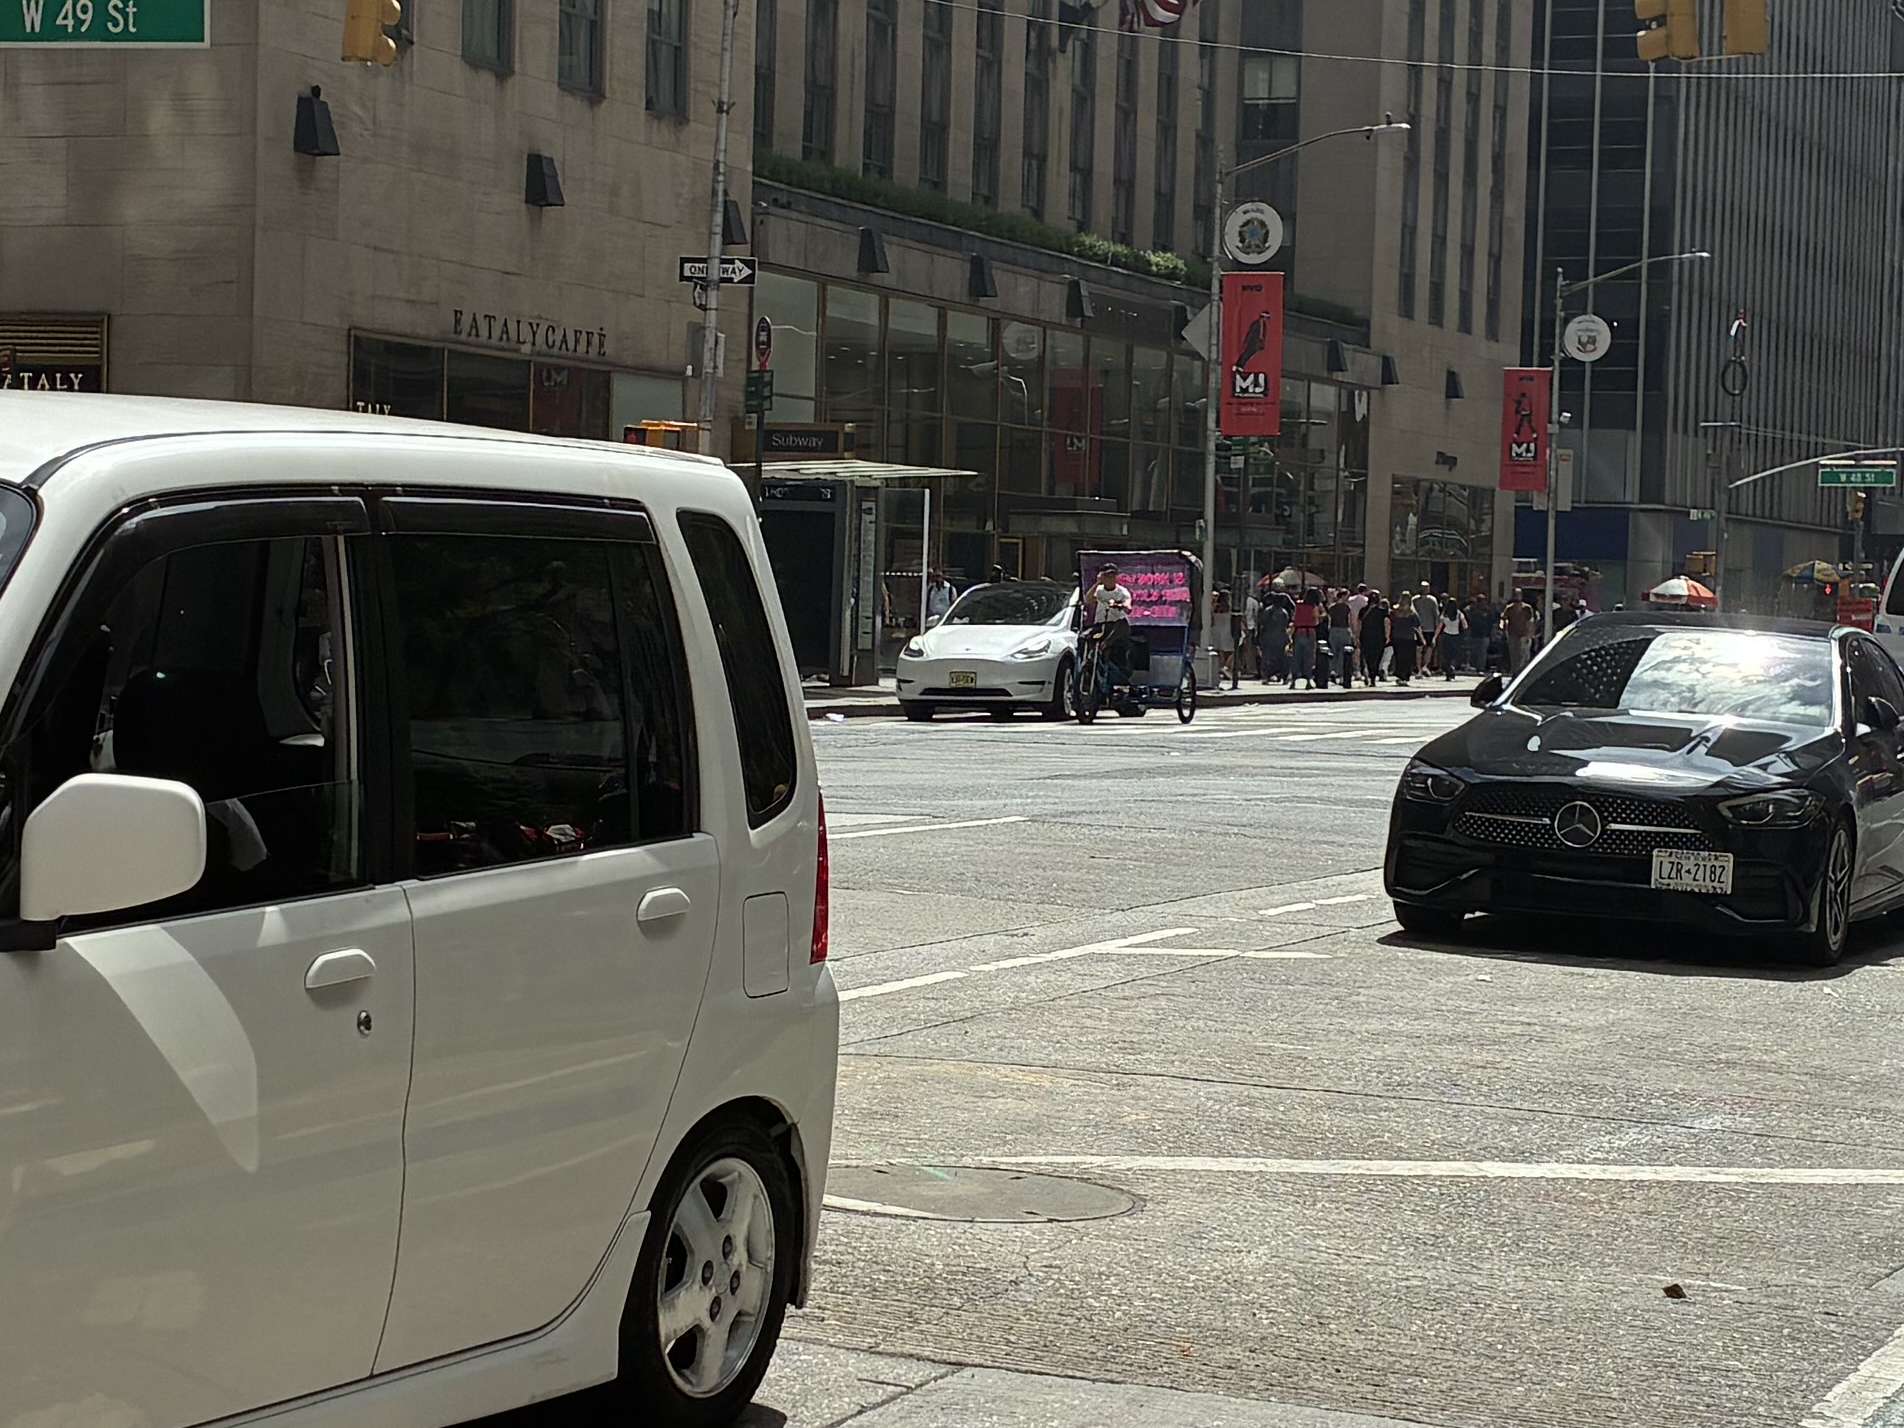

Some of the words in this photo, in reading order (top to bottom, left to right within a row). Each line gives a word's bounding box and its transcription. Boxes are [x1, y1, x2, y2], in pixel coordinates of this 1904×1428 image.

[22, 0, 44, 33] W
[720, 264, 745, 277] WAY
[1235, 373, 1265, 393] MJ
[771, 433, 824, 448] Subway
[1512, 442, 1536, 458] MJ
[1659, 860, 1683, 881] LZR
[1693, 862, 1726, 884] 2182
